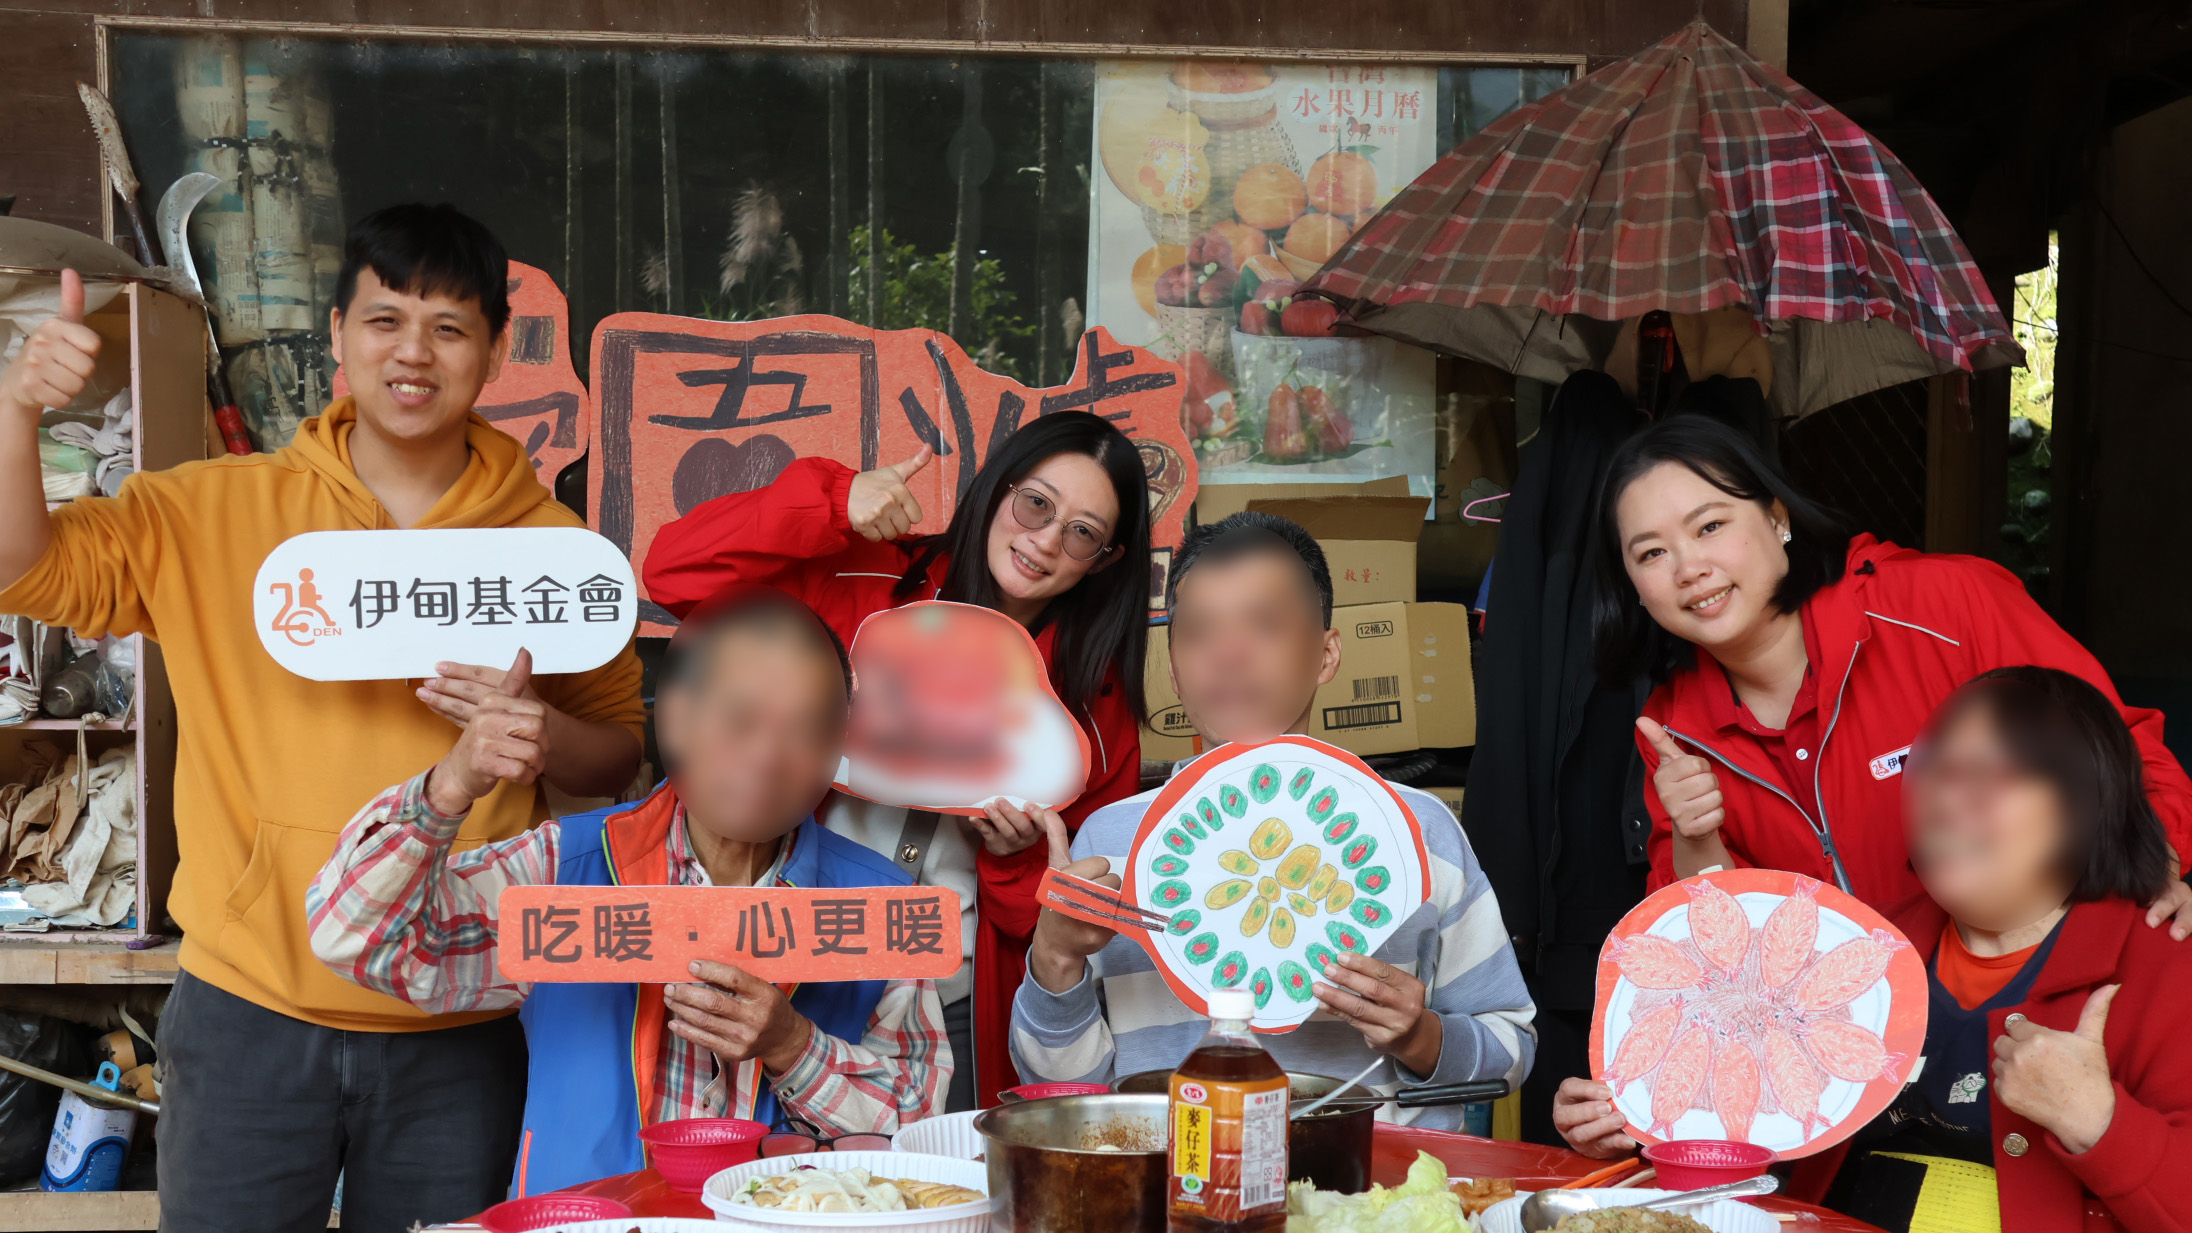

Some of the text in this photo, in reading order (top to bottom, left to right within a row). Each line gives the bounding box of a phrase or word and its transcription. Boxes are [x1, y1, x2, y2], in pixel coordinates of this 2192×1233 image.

[1292, 87, 1421, 120] 水果月曆
[348, 573, 625, 630] 伊甸基金會
[1358, 623, 1391, 636] 12桶入
[1164, 710, 1191, 726] 雞汁
[1186, 1107, 1202, 1174] 麥仔茶
